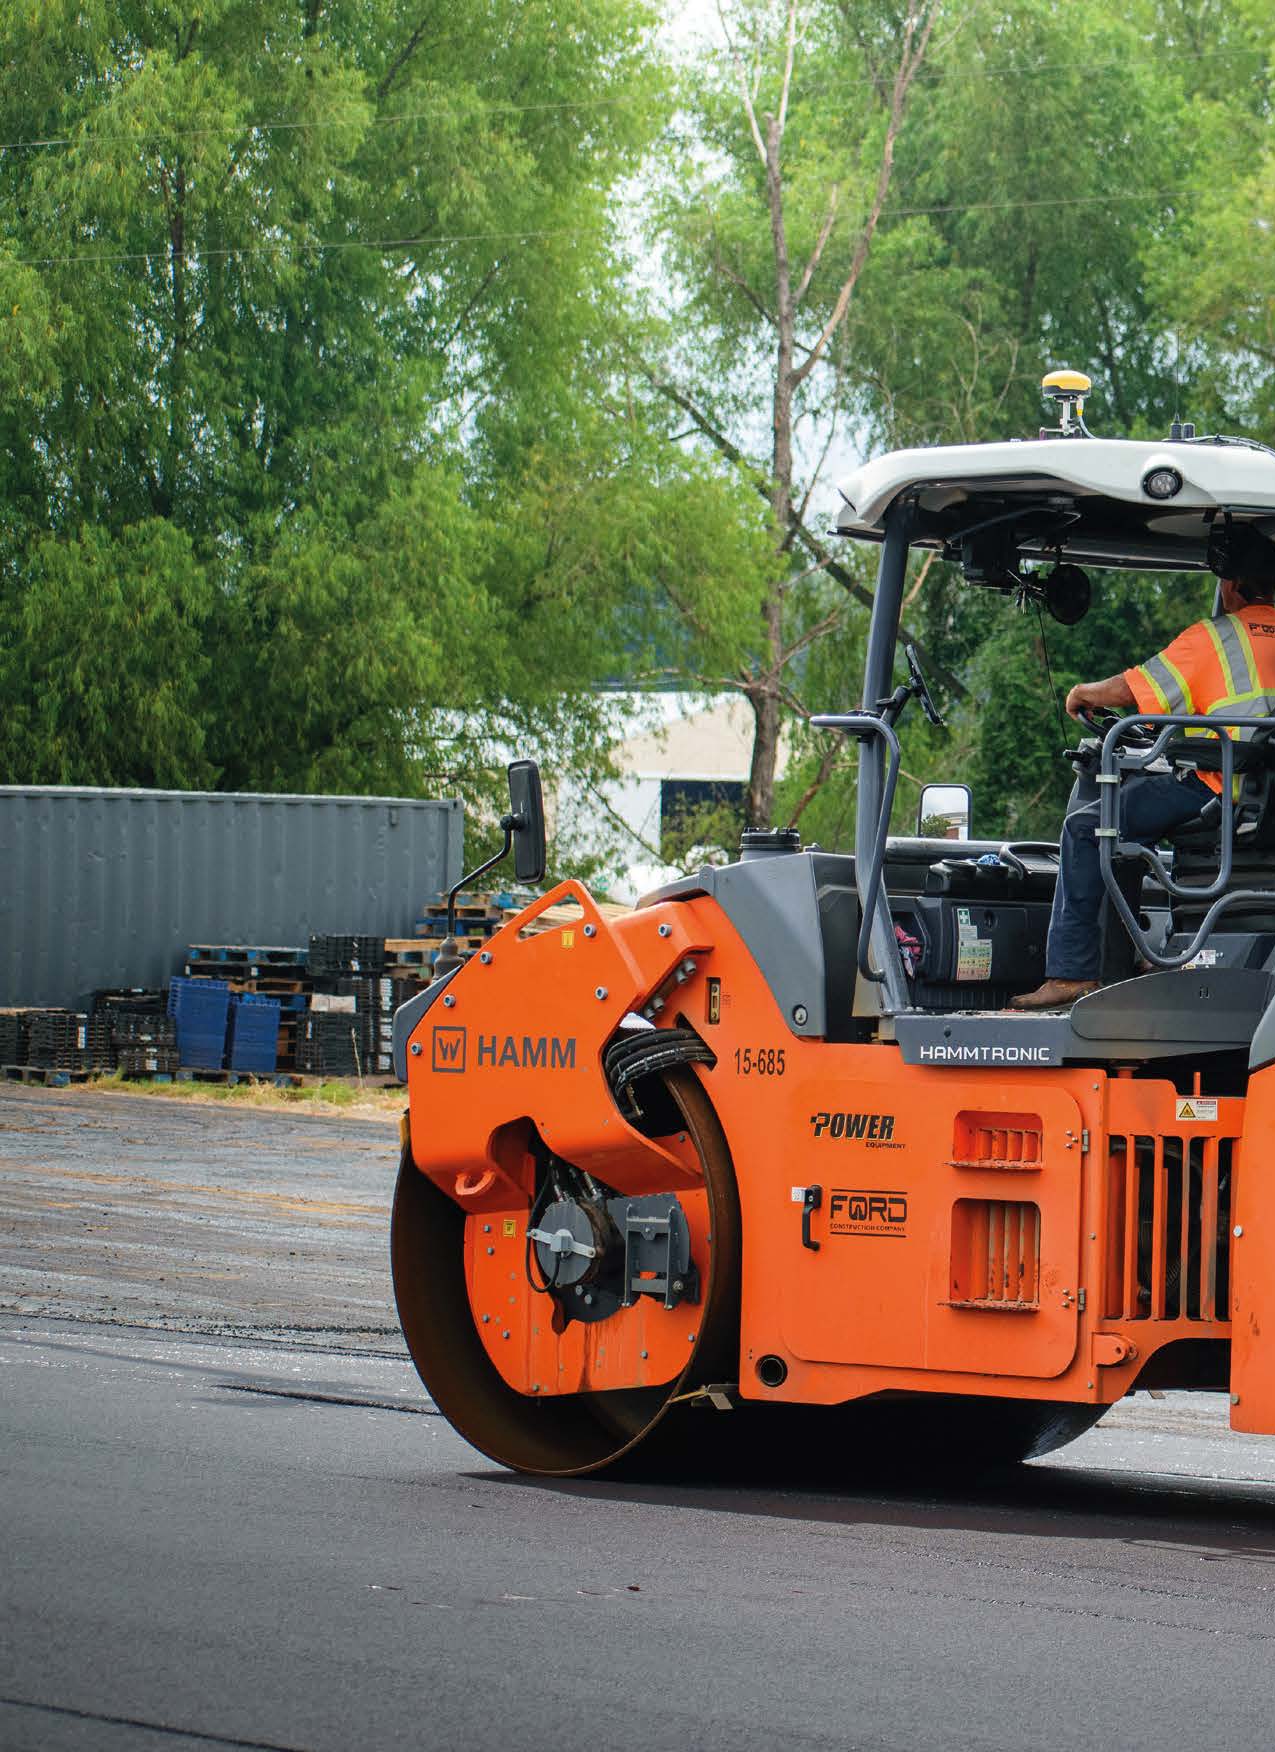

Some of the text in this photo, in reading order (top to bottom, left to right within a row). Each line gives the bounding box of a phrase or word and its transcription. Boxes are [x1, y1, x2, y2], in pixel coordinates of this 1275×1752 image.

[477, 1035, 577, 1069] HAMM
[735, 1048, 785, 1076] 15-685
[919, 1045, 1051, 1061] HAMMTRONIC
[810, 1112, 895, 1141] POWER
[865, 1141, 906, 1150] EQUIPMENT
[830, 1195, 907, 1223] FORD
[829, 1223, 905, 1232] CONSTRUCTION COMPANY
